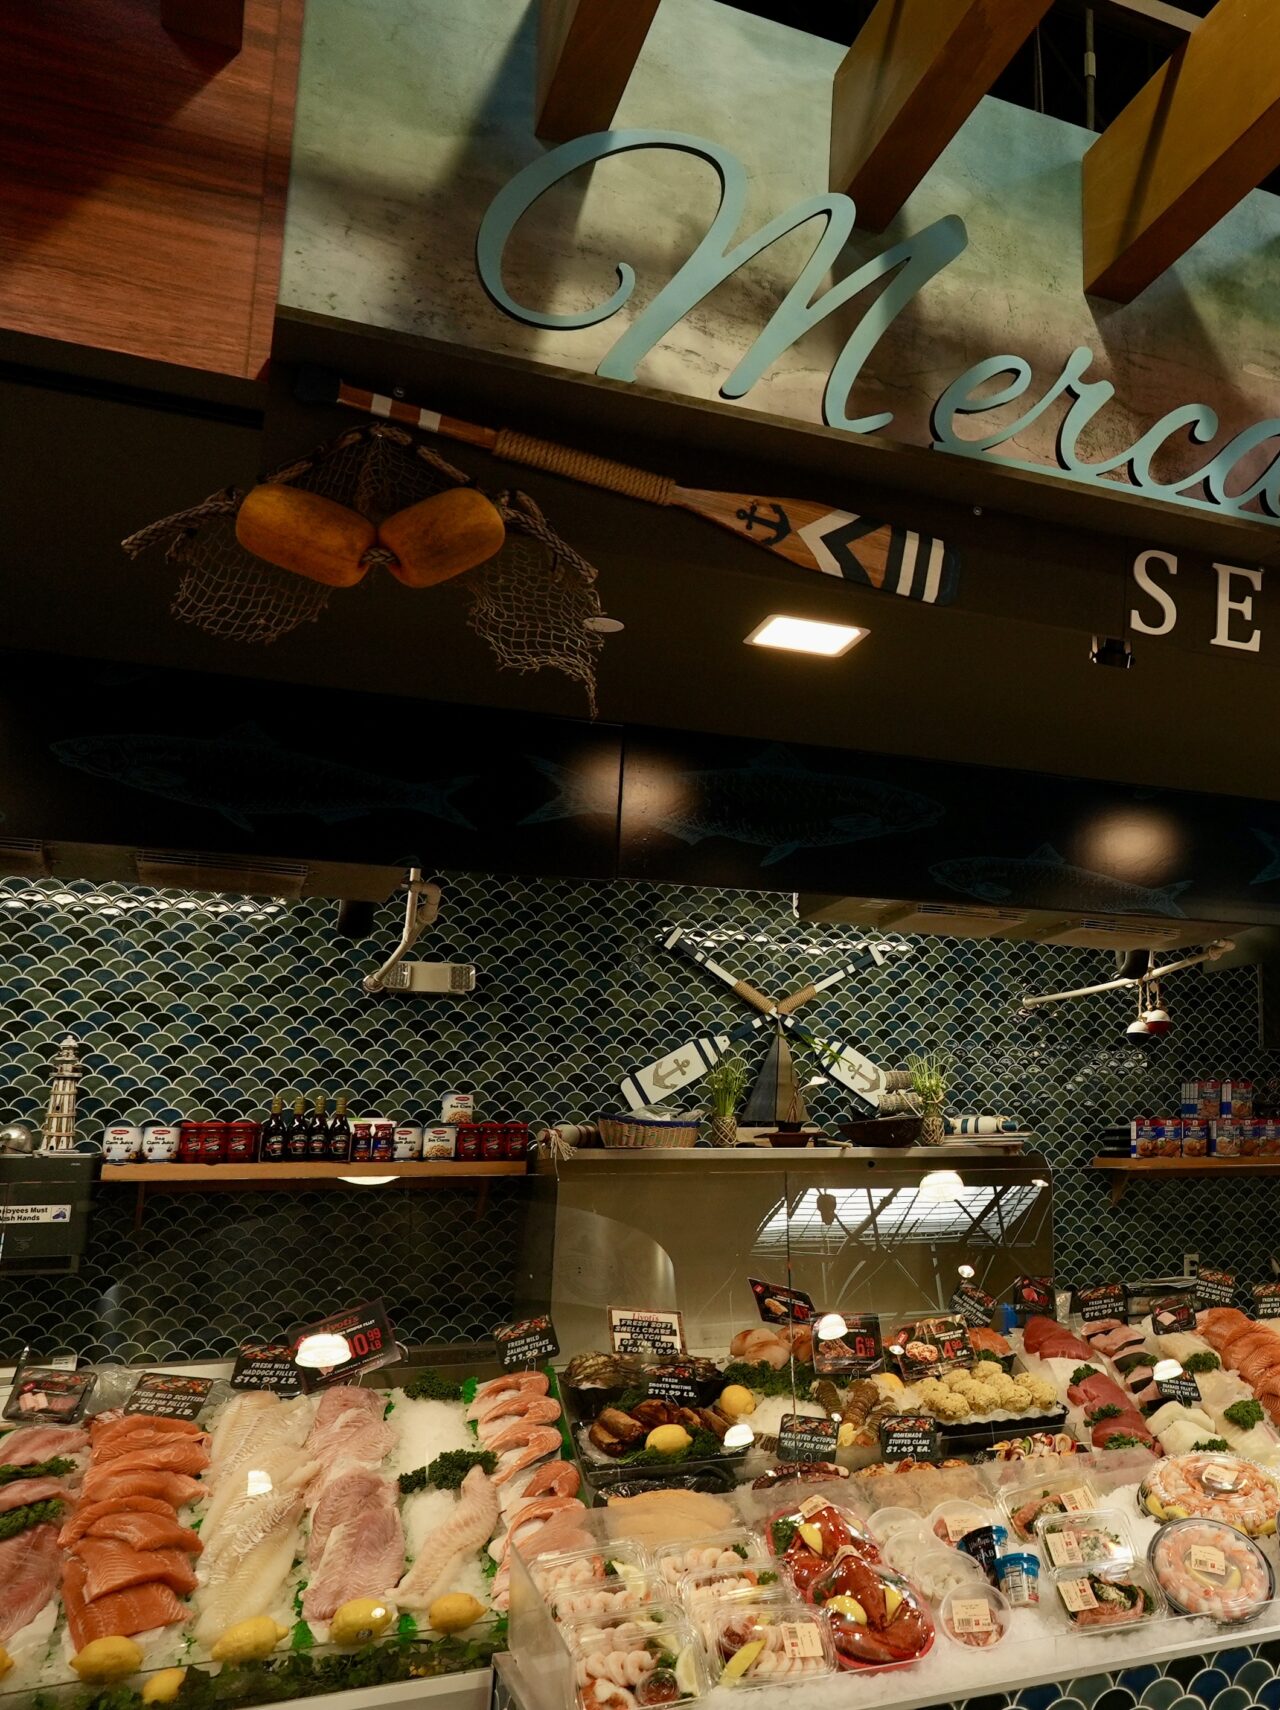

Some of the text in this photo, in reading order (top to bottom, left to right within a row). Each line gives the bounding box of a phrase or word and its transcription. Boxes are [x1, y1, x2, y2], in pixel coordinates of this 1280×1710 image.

[620, 1319, 649, 1327] FRESH
[367, 1327, 382, 1340] 99
[347, 1333, 369, 1358] 10
[371, 1340, 382, 1351] LB
[506, 1339, 549, 1356] SALMON STEAKS
[507, 1334, 540, 1349] FRESH WILD
[855, 1336, 866, 1356] 6
[503, 1344, 556, 1365] $11.99 LB.
[943, 1341, 955, 1360] 4
[956, 1349, 970, 1357] EA.
[242, 1368, 275, 1376] HADDOCK
[280, 1377, 298, 1385] LB.
[138, 1398, 166, 1406] SALMON
[173, 1394, 206, 1402] SCOTTISH
[128, 1403, 194, 1416] $16.99 LB.
[885, 1445, 931, 1453] $1.49 EA.
